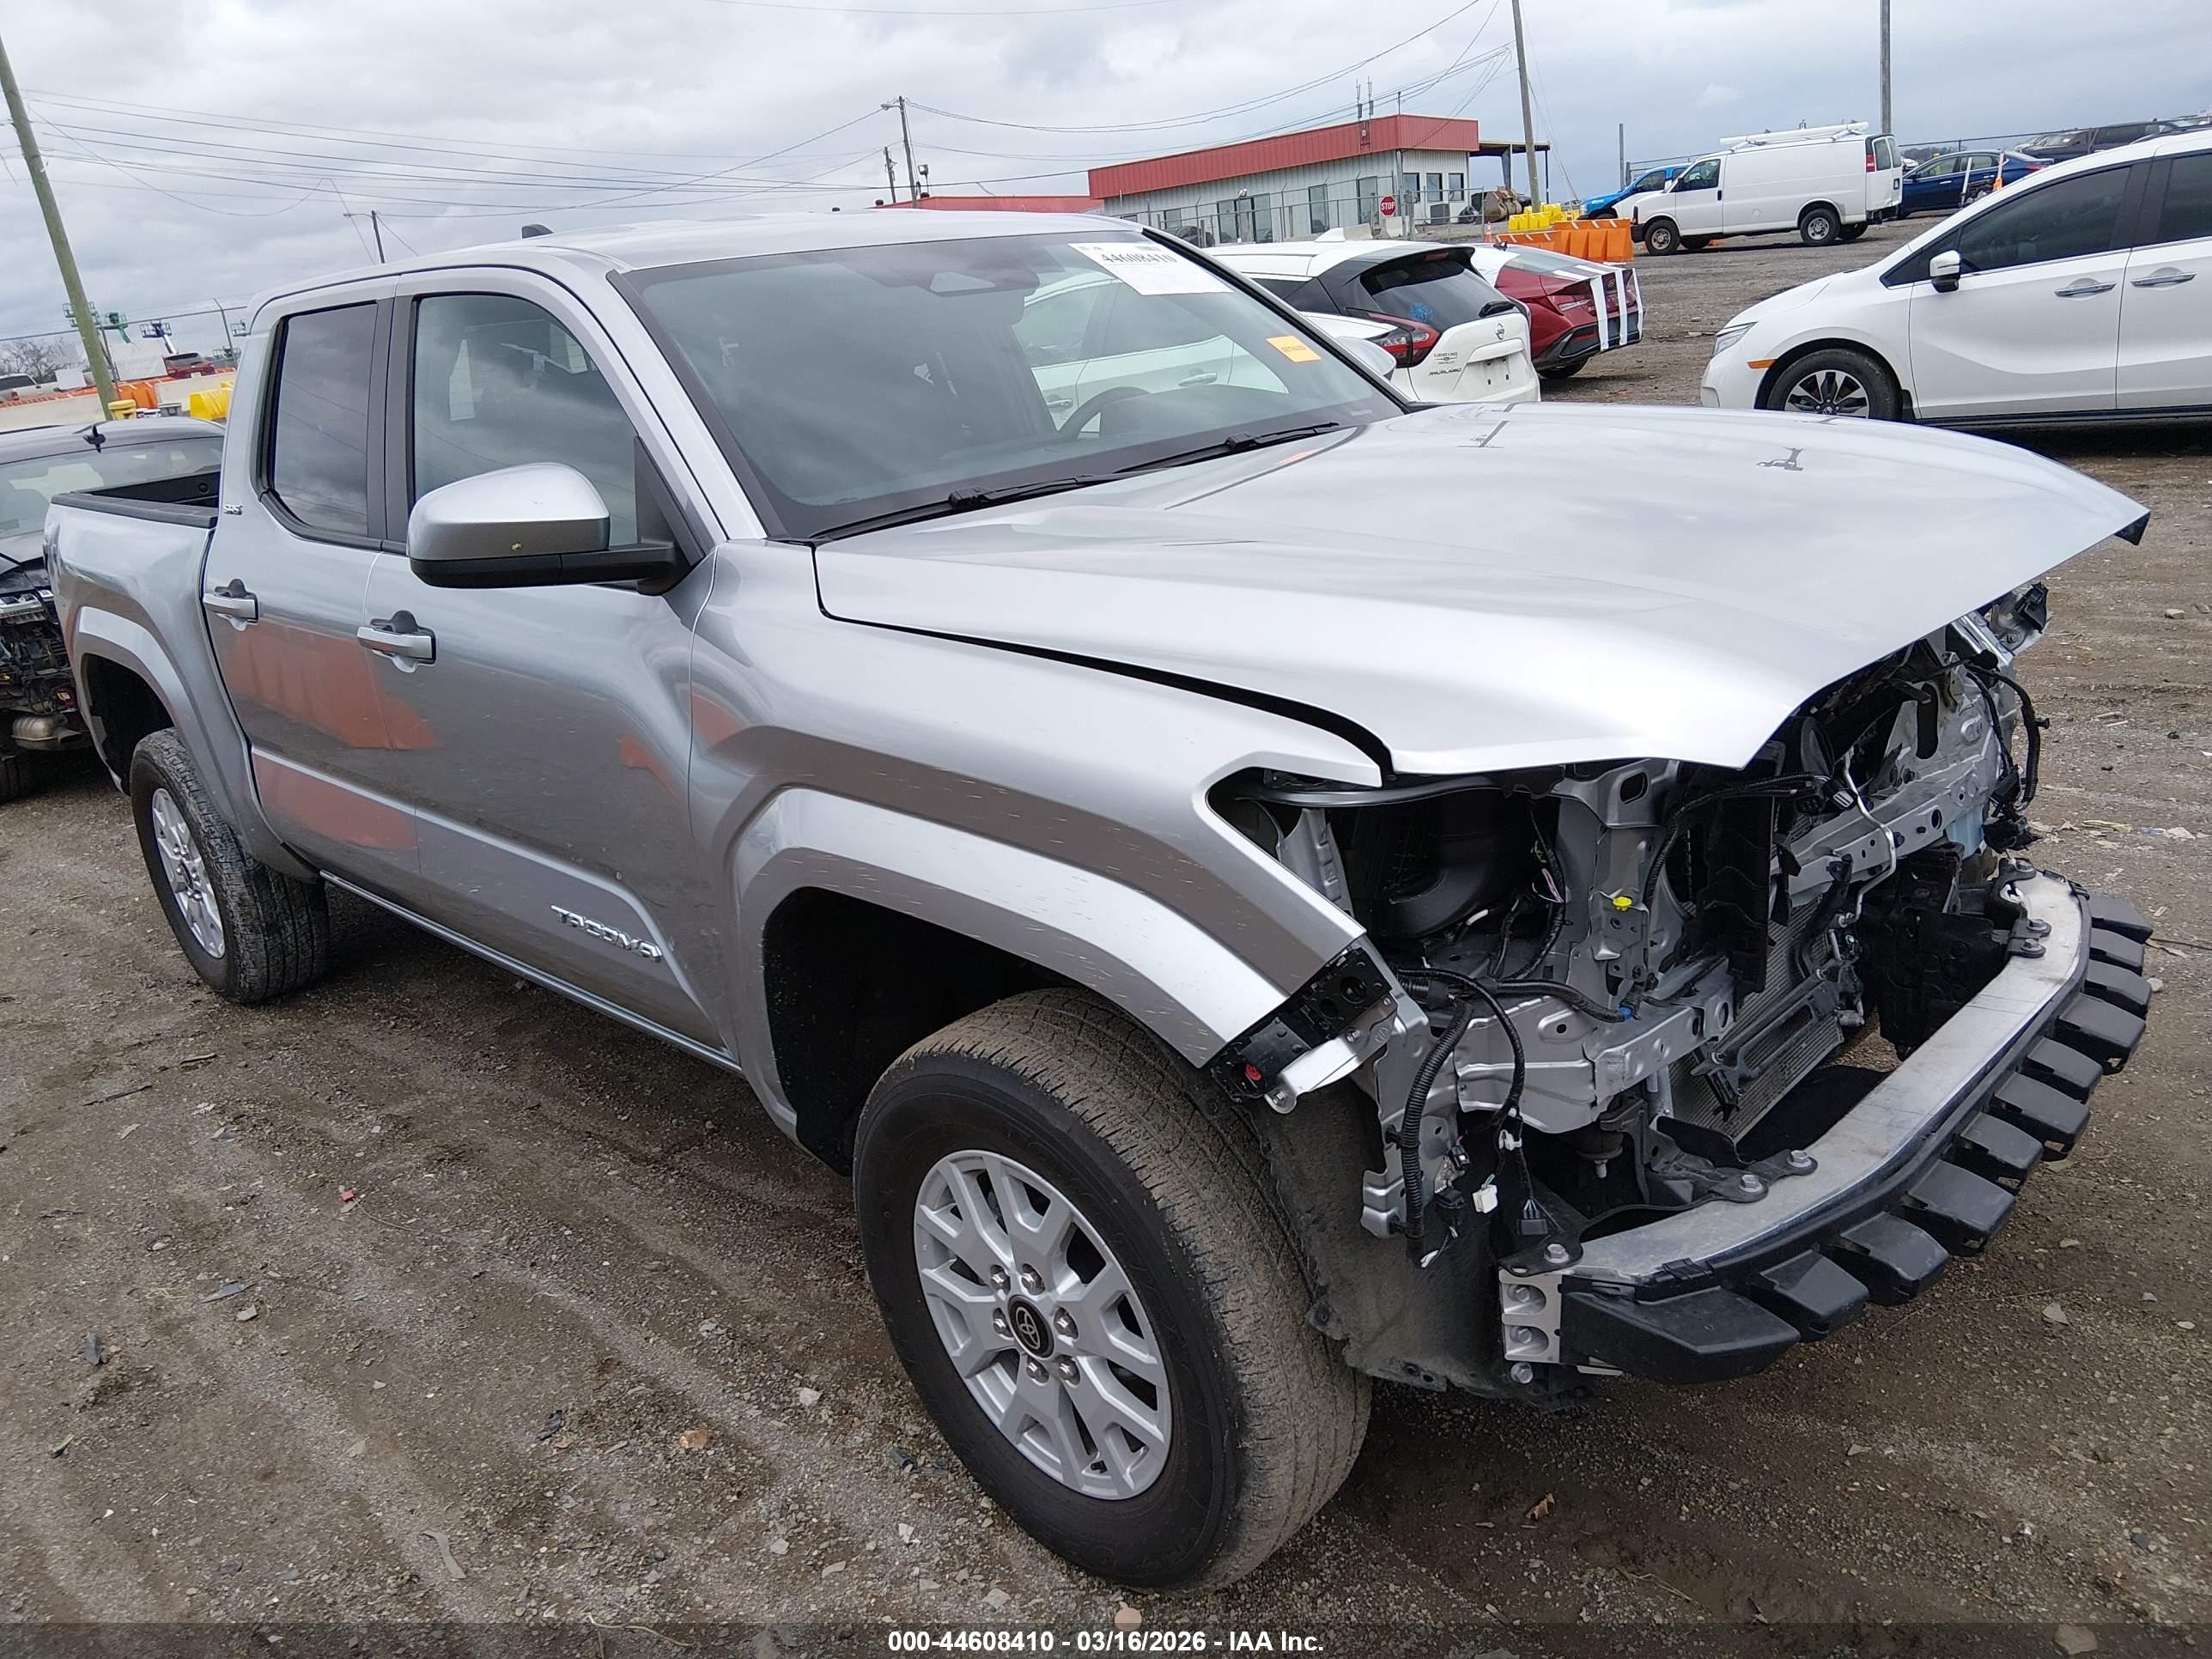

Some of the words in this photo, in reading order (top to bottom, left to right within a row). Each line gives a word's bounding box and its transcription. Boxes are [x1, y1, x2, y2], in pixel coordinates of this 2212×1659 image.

[1381, 201, 1395, 210] STOP
[1100, 253, 1178, 264] 44608410
[550, 904, 663, 962] TACOMA
